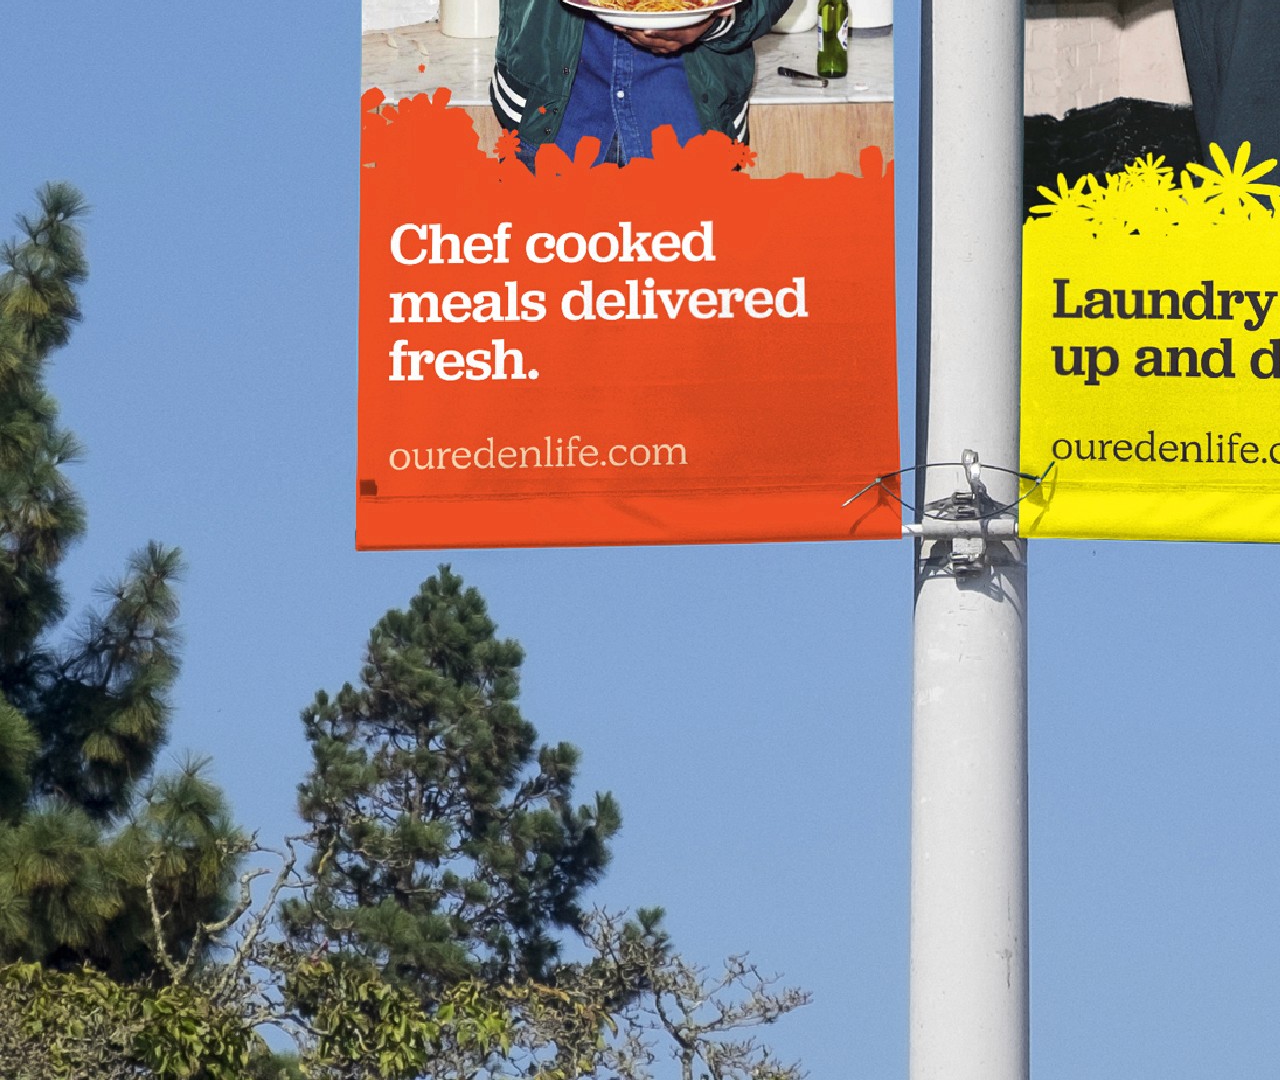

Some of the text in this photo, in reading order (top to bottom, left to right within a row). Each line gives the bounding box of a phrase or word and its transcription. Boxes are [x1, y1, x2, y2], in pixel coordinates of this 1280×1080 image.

[389, 221, 716, 266] Chef cooked
[389, 277, 808, 323] meals delivered
[1053, 280, 1278, 331] Laundry
[389, 339, 539, 381] fresh.
[1051, 346, 1119, 385] up
[1135, 338, 1235, 378] and
[389, 435, 687, 470] ouredenlife.com
